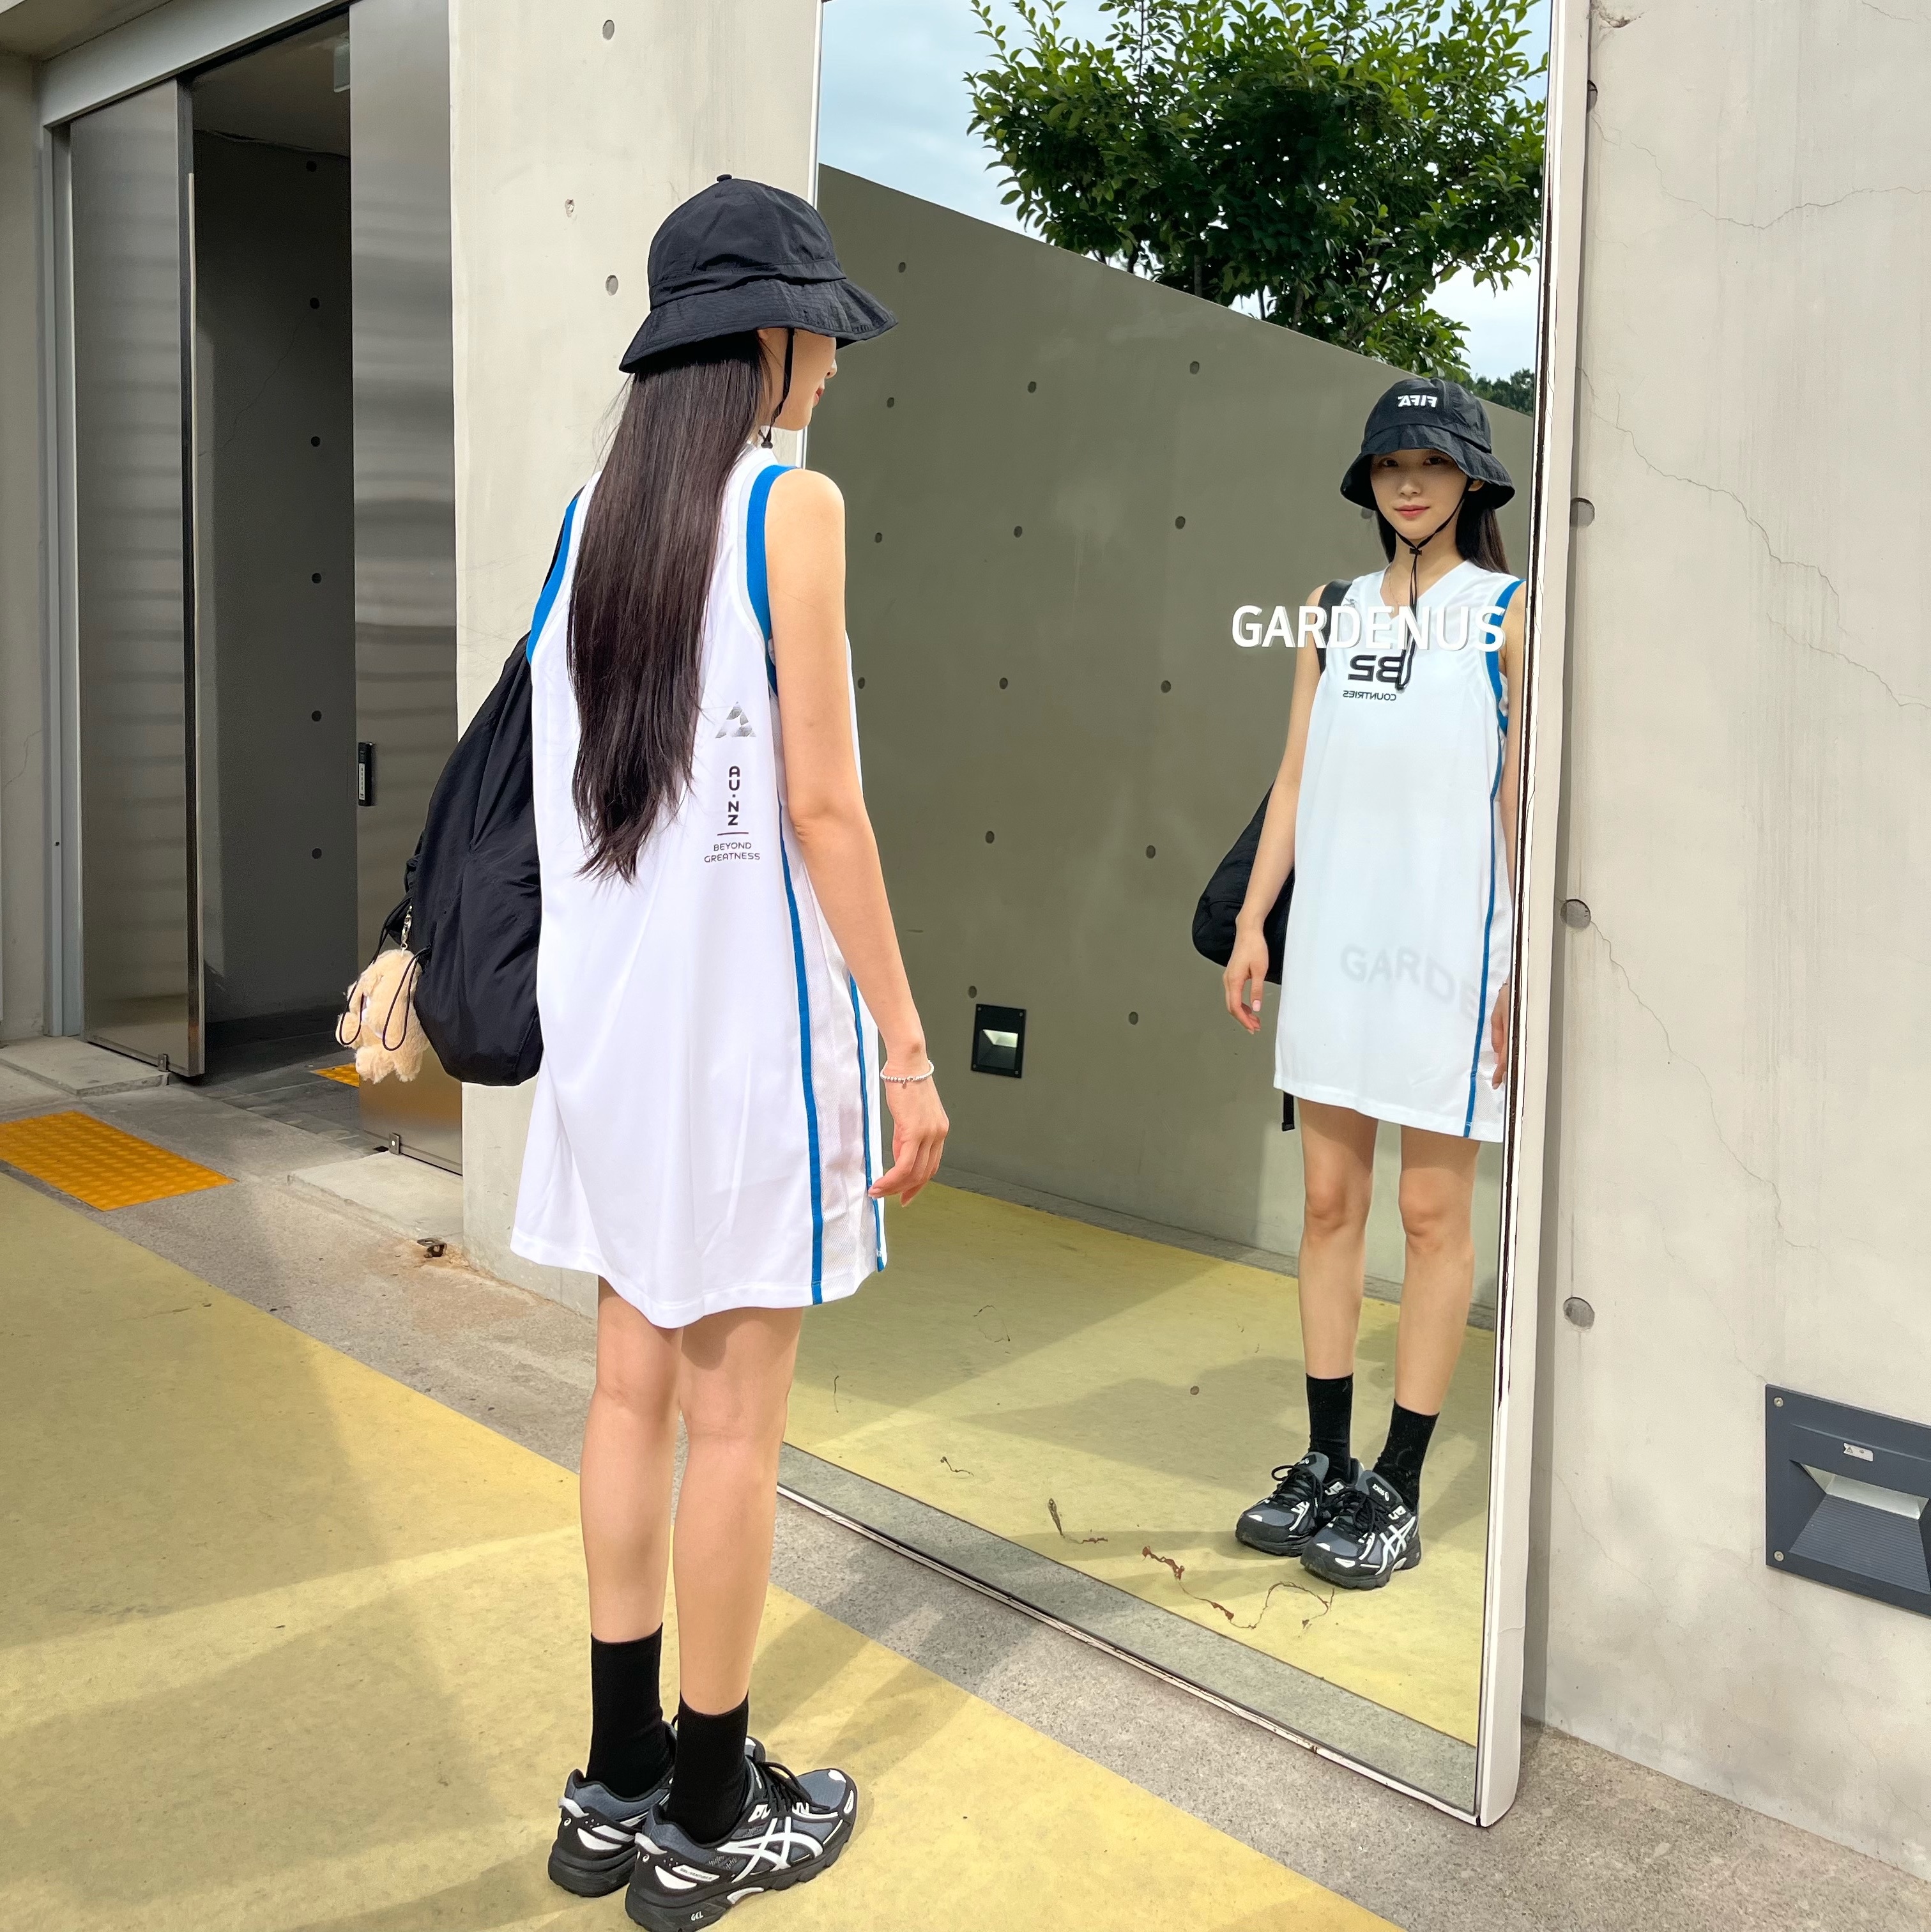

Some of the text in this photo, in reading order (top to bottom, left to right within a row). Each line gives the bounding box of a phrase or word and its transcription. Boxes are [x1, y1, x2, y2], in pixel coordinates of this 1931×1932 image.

[1232, 604, 1506, 652] GARDENUS
[713, 842, 752, 852] BEYOND
[704, 852, 760, 862] GREATNESS
